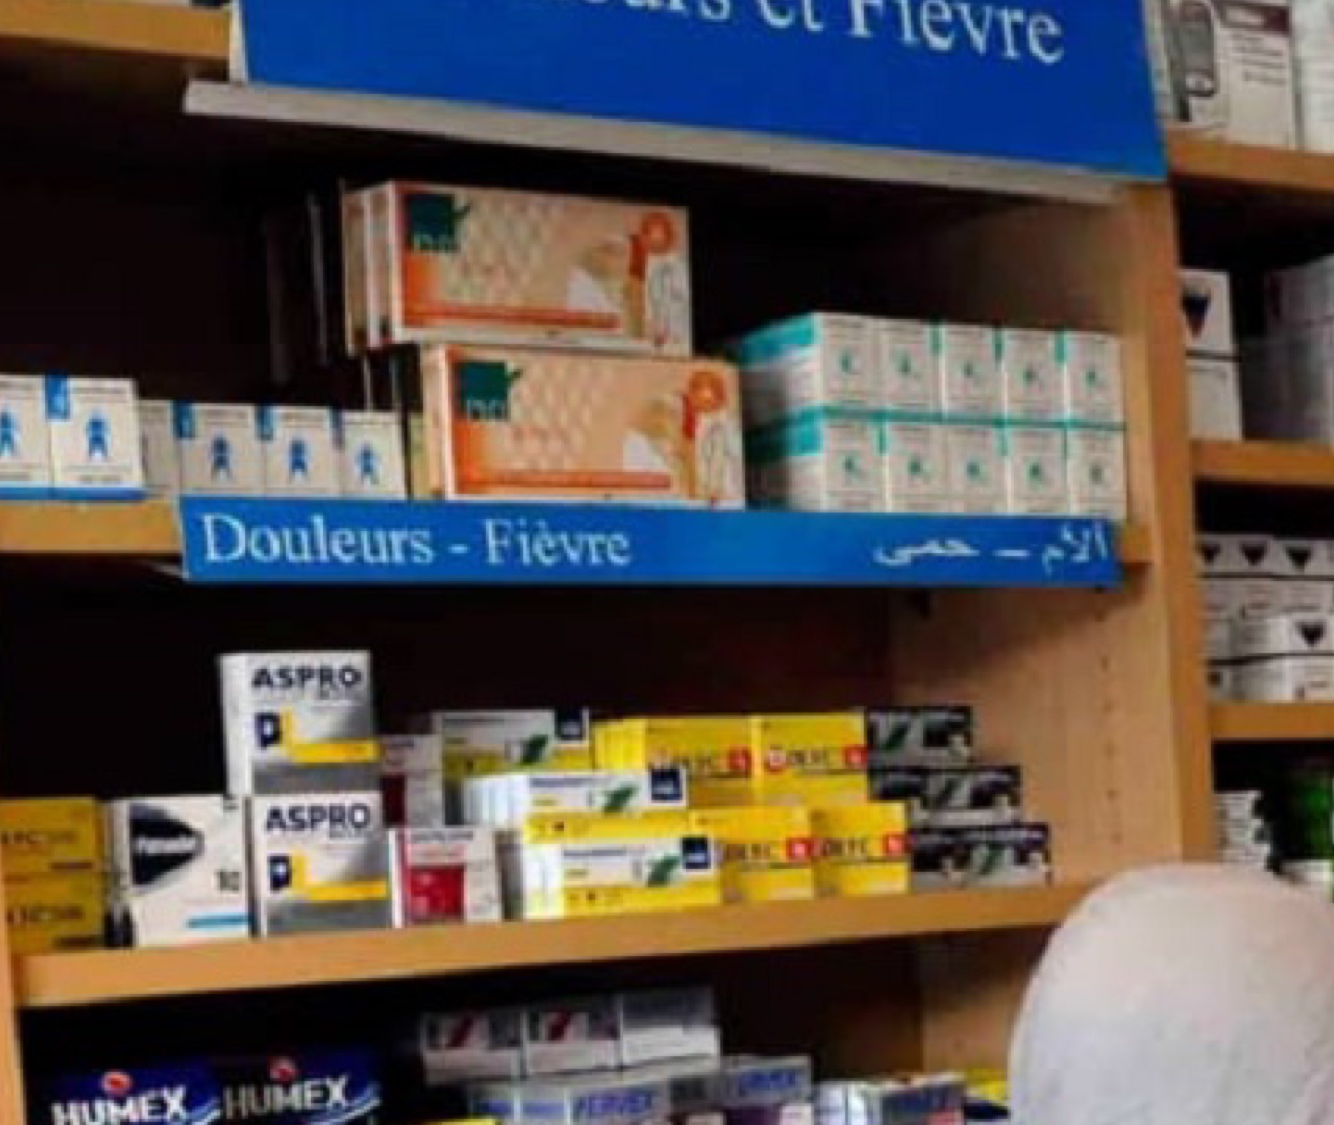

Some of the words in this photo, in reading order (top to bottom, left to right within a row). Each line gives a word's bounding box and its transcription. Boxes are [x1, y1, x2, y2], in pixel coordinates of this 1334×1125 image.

[201, 513, 435, 564] Douleurs
[483, 518, 632, 567] Fièvre
[252, 663, 363, 690] ASPRO
[265, 803, 371, 831] ASPRO
[224, 1075, 349, 1119] HUMEX
